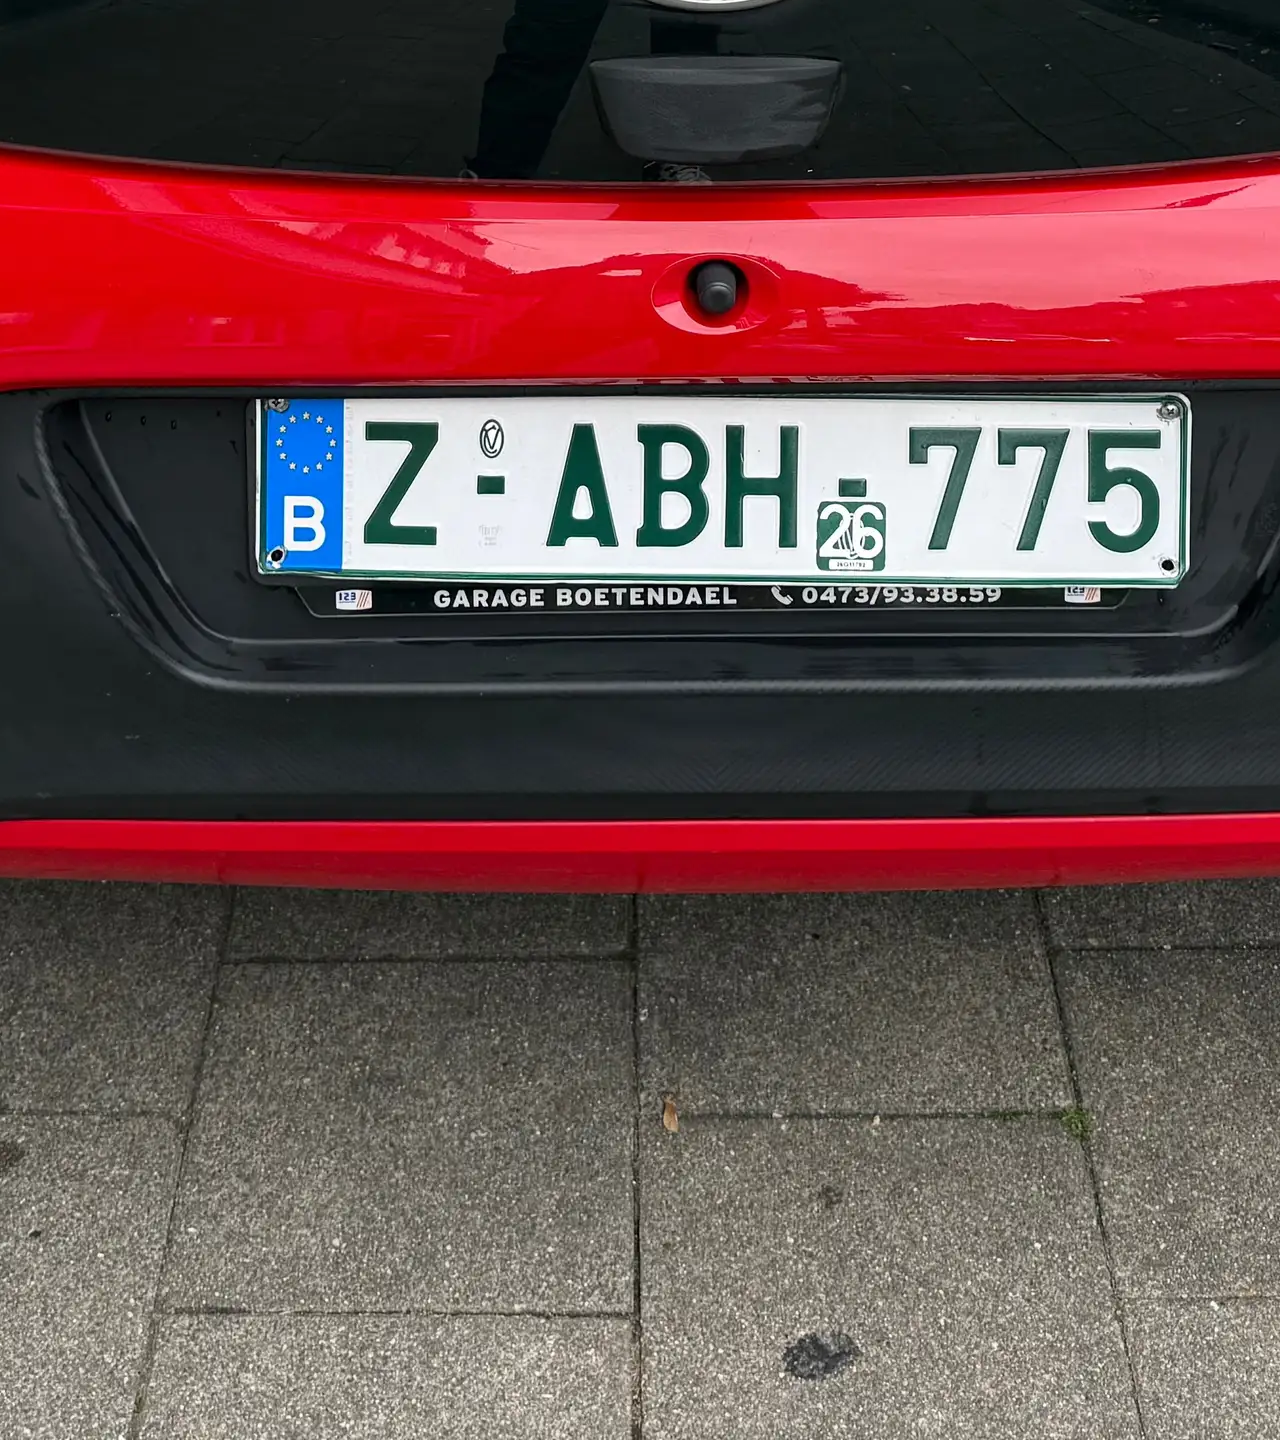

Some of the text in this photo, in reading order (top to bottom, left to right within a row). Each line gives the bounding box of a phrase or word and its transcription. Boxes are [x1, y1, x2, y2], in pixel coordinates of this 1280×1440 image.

[283, 495, 326, 552] B
[818, 503, 884, 560] 26
[433, 587, 737, 608] GARAGE BOETENDAEL
[802, 586, 1002, 605] 0473/93.38.59
